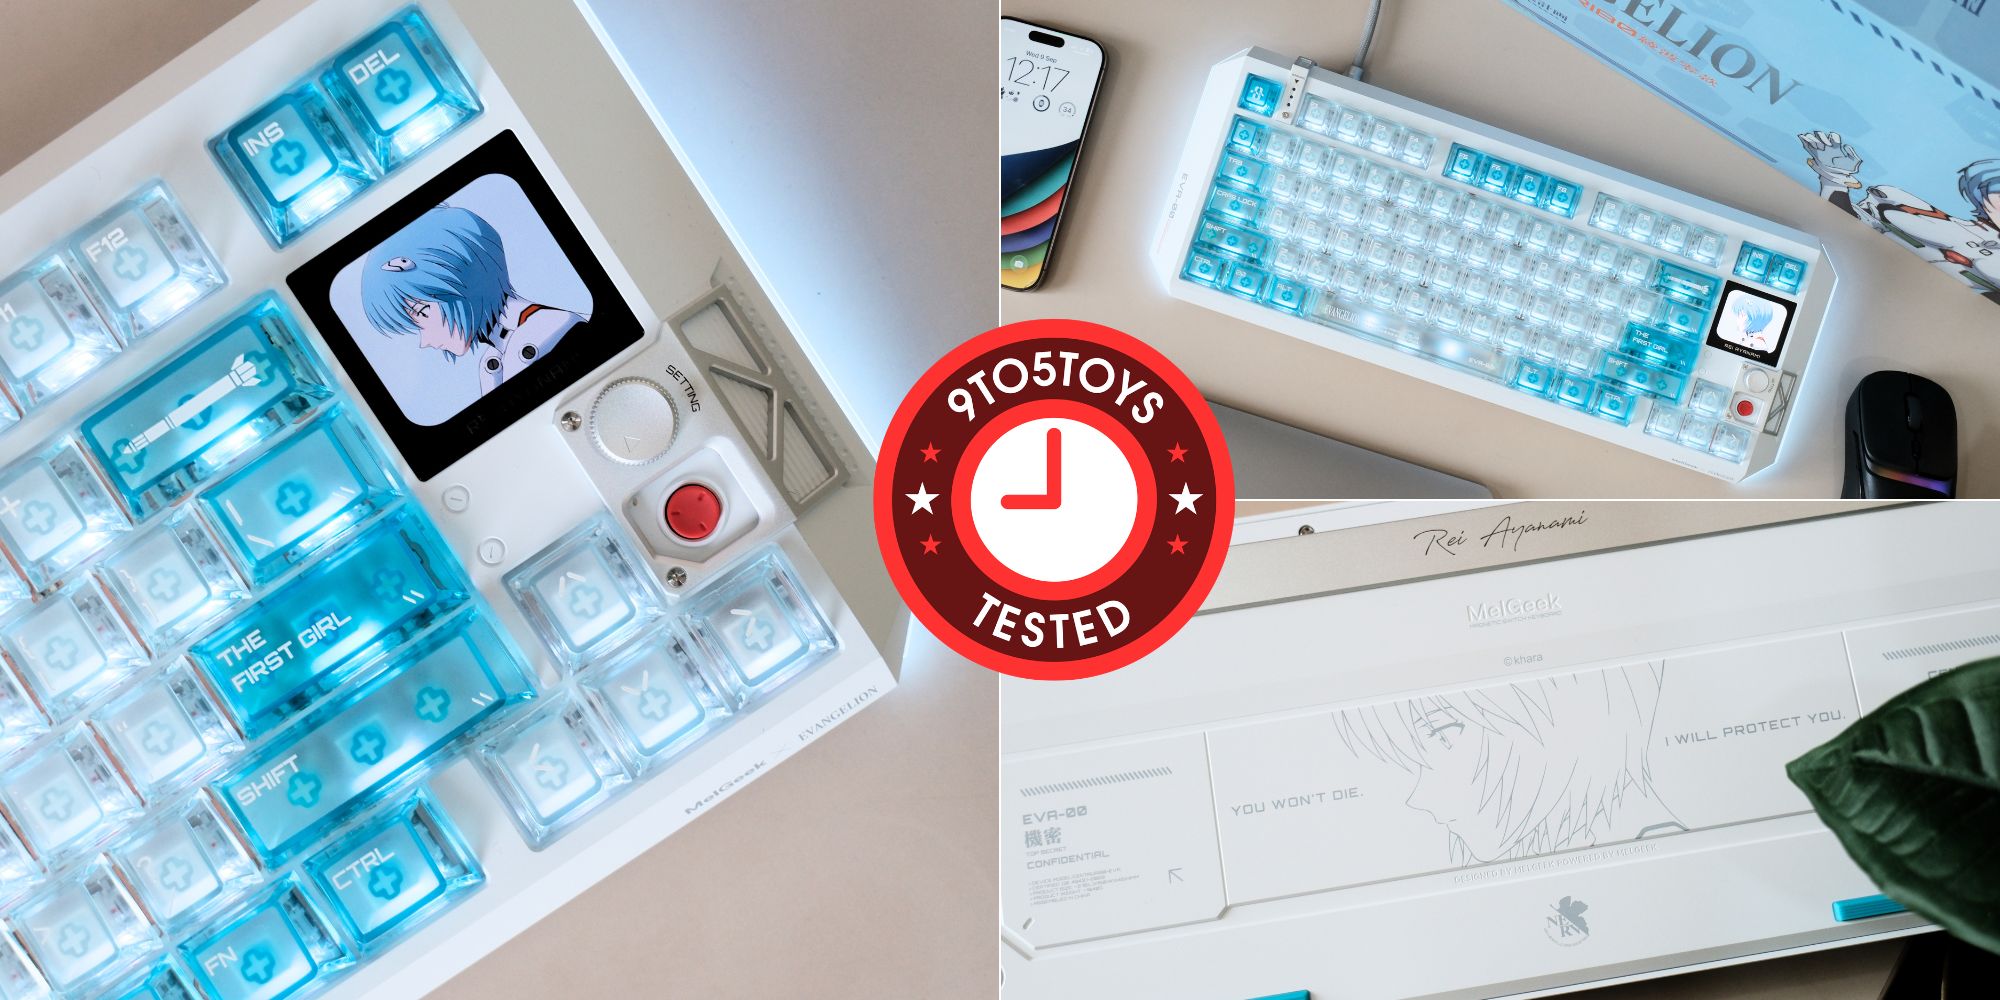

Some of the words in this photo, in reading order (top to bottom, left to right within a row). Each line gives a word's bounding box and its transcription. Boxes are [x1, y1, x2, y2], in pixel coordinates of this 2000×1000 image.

[347, 48, 400, 85] DEL
[1026, 50, 1039, 59] Wed
[1046, 56, 1057, 64] Sep
[1603, 0, 1801, 106] ELION
[1007, 57, 1070, 92] 12:17
[243, 121, 285, 157] INS
[1408, 134, 1419, 142] F4
[1227, 156, 1243, 166] TAB
[1236, 195, 1257, 207] LOCK
[1205, 222, 1227, 234] SHIFT
[84, 227, 129, 263] F12
[1194, 255, 1214, 266] CTRL
[1783, 262, 1799, 272] DEL
[1276, 282, 1292, 292] ALT
[1631, 337, 1652, 348] FIRST
[1635, 329, 1650, 340] THE
[1607, 357, 1628, 368] SHIFT
[665, 364, 701, 413] SETTING
[1604, 392, 1624, 403] CTRL
[1413, 529, 1468, 556] Rei
[1480, 510, 1590, 552] Ayanami
[1466, 592, 1562, 622] MelGeek
[216, 629, 267, 667] THE
[231, 641, 295, 694] FIRST
[298, 611, 353, 651] GIRL
[1675, 731, 1717, 744] WILL
[1723, 716, 1801, 738] PROTECT
[1808, 709, 1846, 724] YOU.
[684, 759, 768, 815] MelGeek
[798, 685, 879, 741] EVANGELION
[236, 753, 300, 807] SHIFT
[1022, 805, 1088, 825] EVA-00
[1231, 802, 1265, 816] YOU
[1272, 792, 1326, 810] WON'T
[1332, 787, 1364, 801] DIE.
[1024, 826, 1062, 849] 機密
[331, 846, 396, 891] CTRL
[1027, 850, 1110, 870] CONFIDENTIAL
[1454, 869, 1499, 885] DESIGNED
[1514, 859, 1555, 877] MELGEEK
[1557, 853, 1602, 868] POWERED
[1617, 843, 1658, 858] MELGEEK
[204, 946, 239, 977] FN
